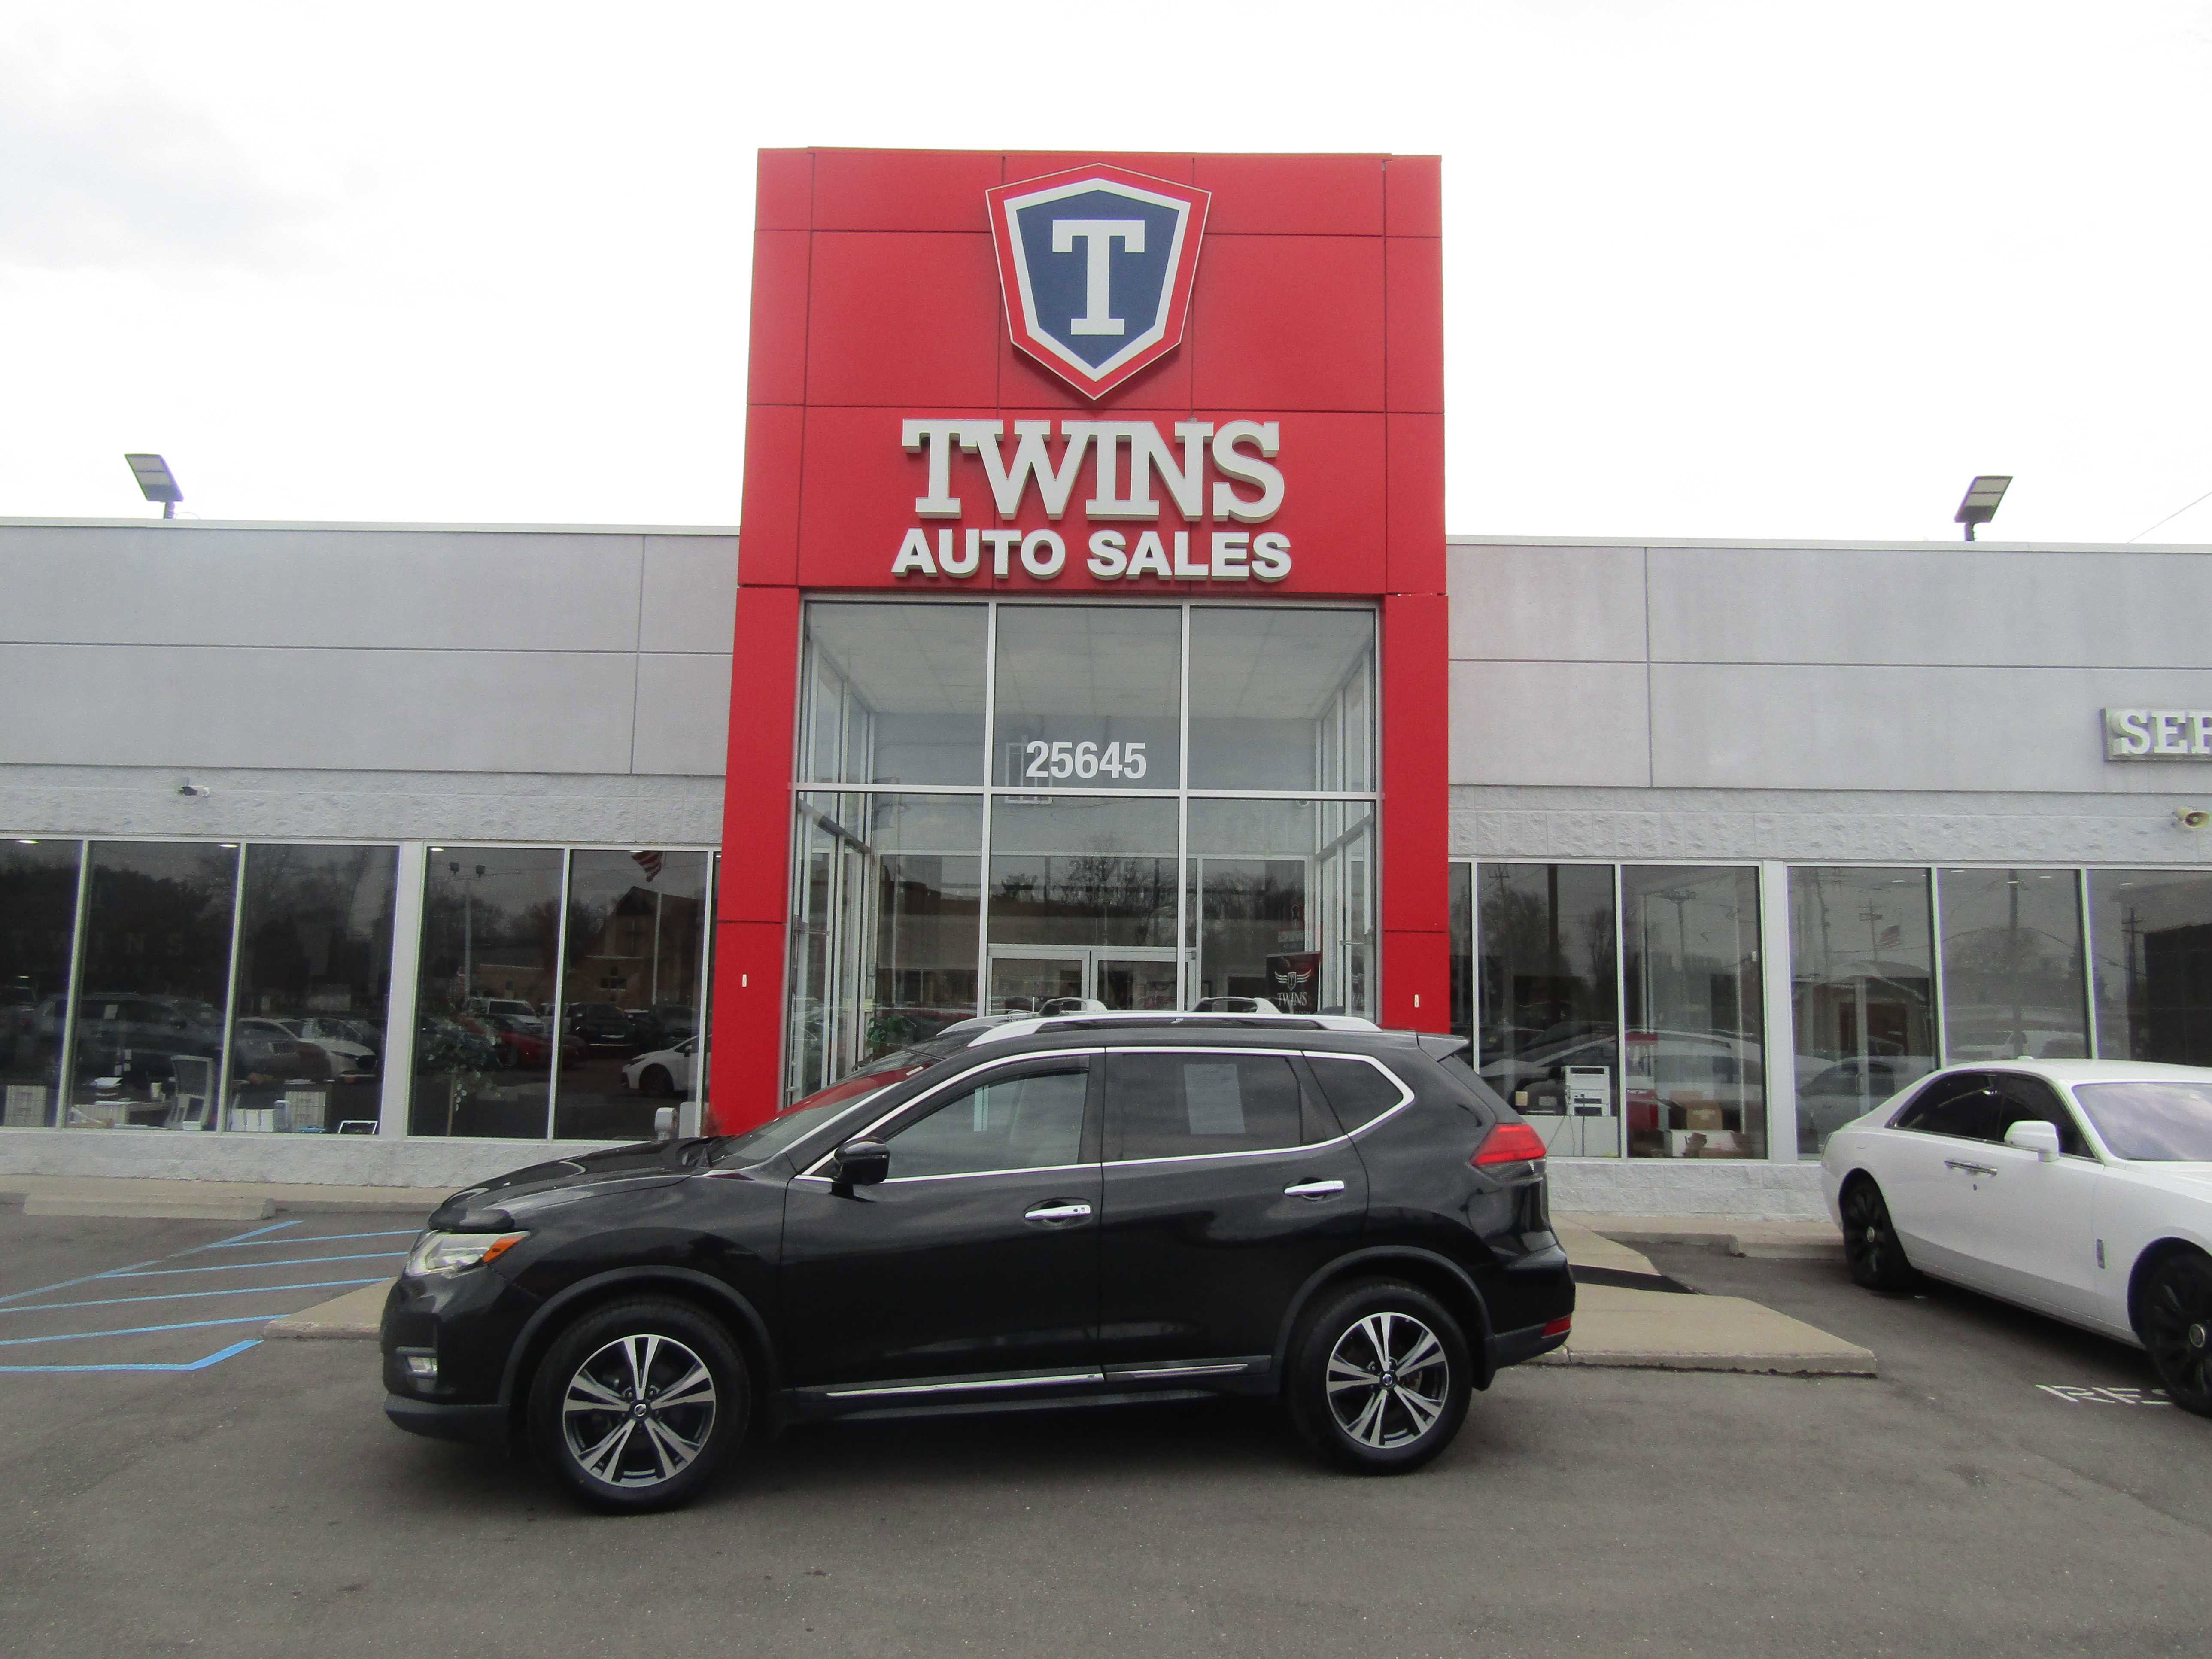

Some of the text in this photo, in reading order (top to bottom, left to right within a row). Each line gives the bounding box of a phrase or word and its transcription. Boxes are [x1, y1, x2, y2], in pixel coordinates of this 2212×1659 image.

[1052, 219, 1145, 335] T
[902, 418, 1285, 523] TWINS
[891, 528, 1291, 582] AUTO SALES
[1026, 741, 1147, 779] 25645
[1277, 992, 1307, 1006] TWINS
